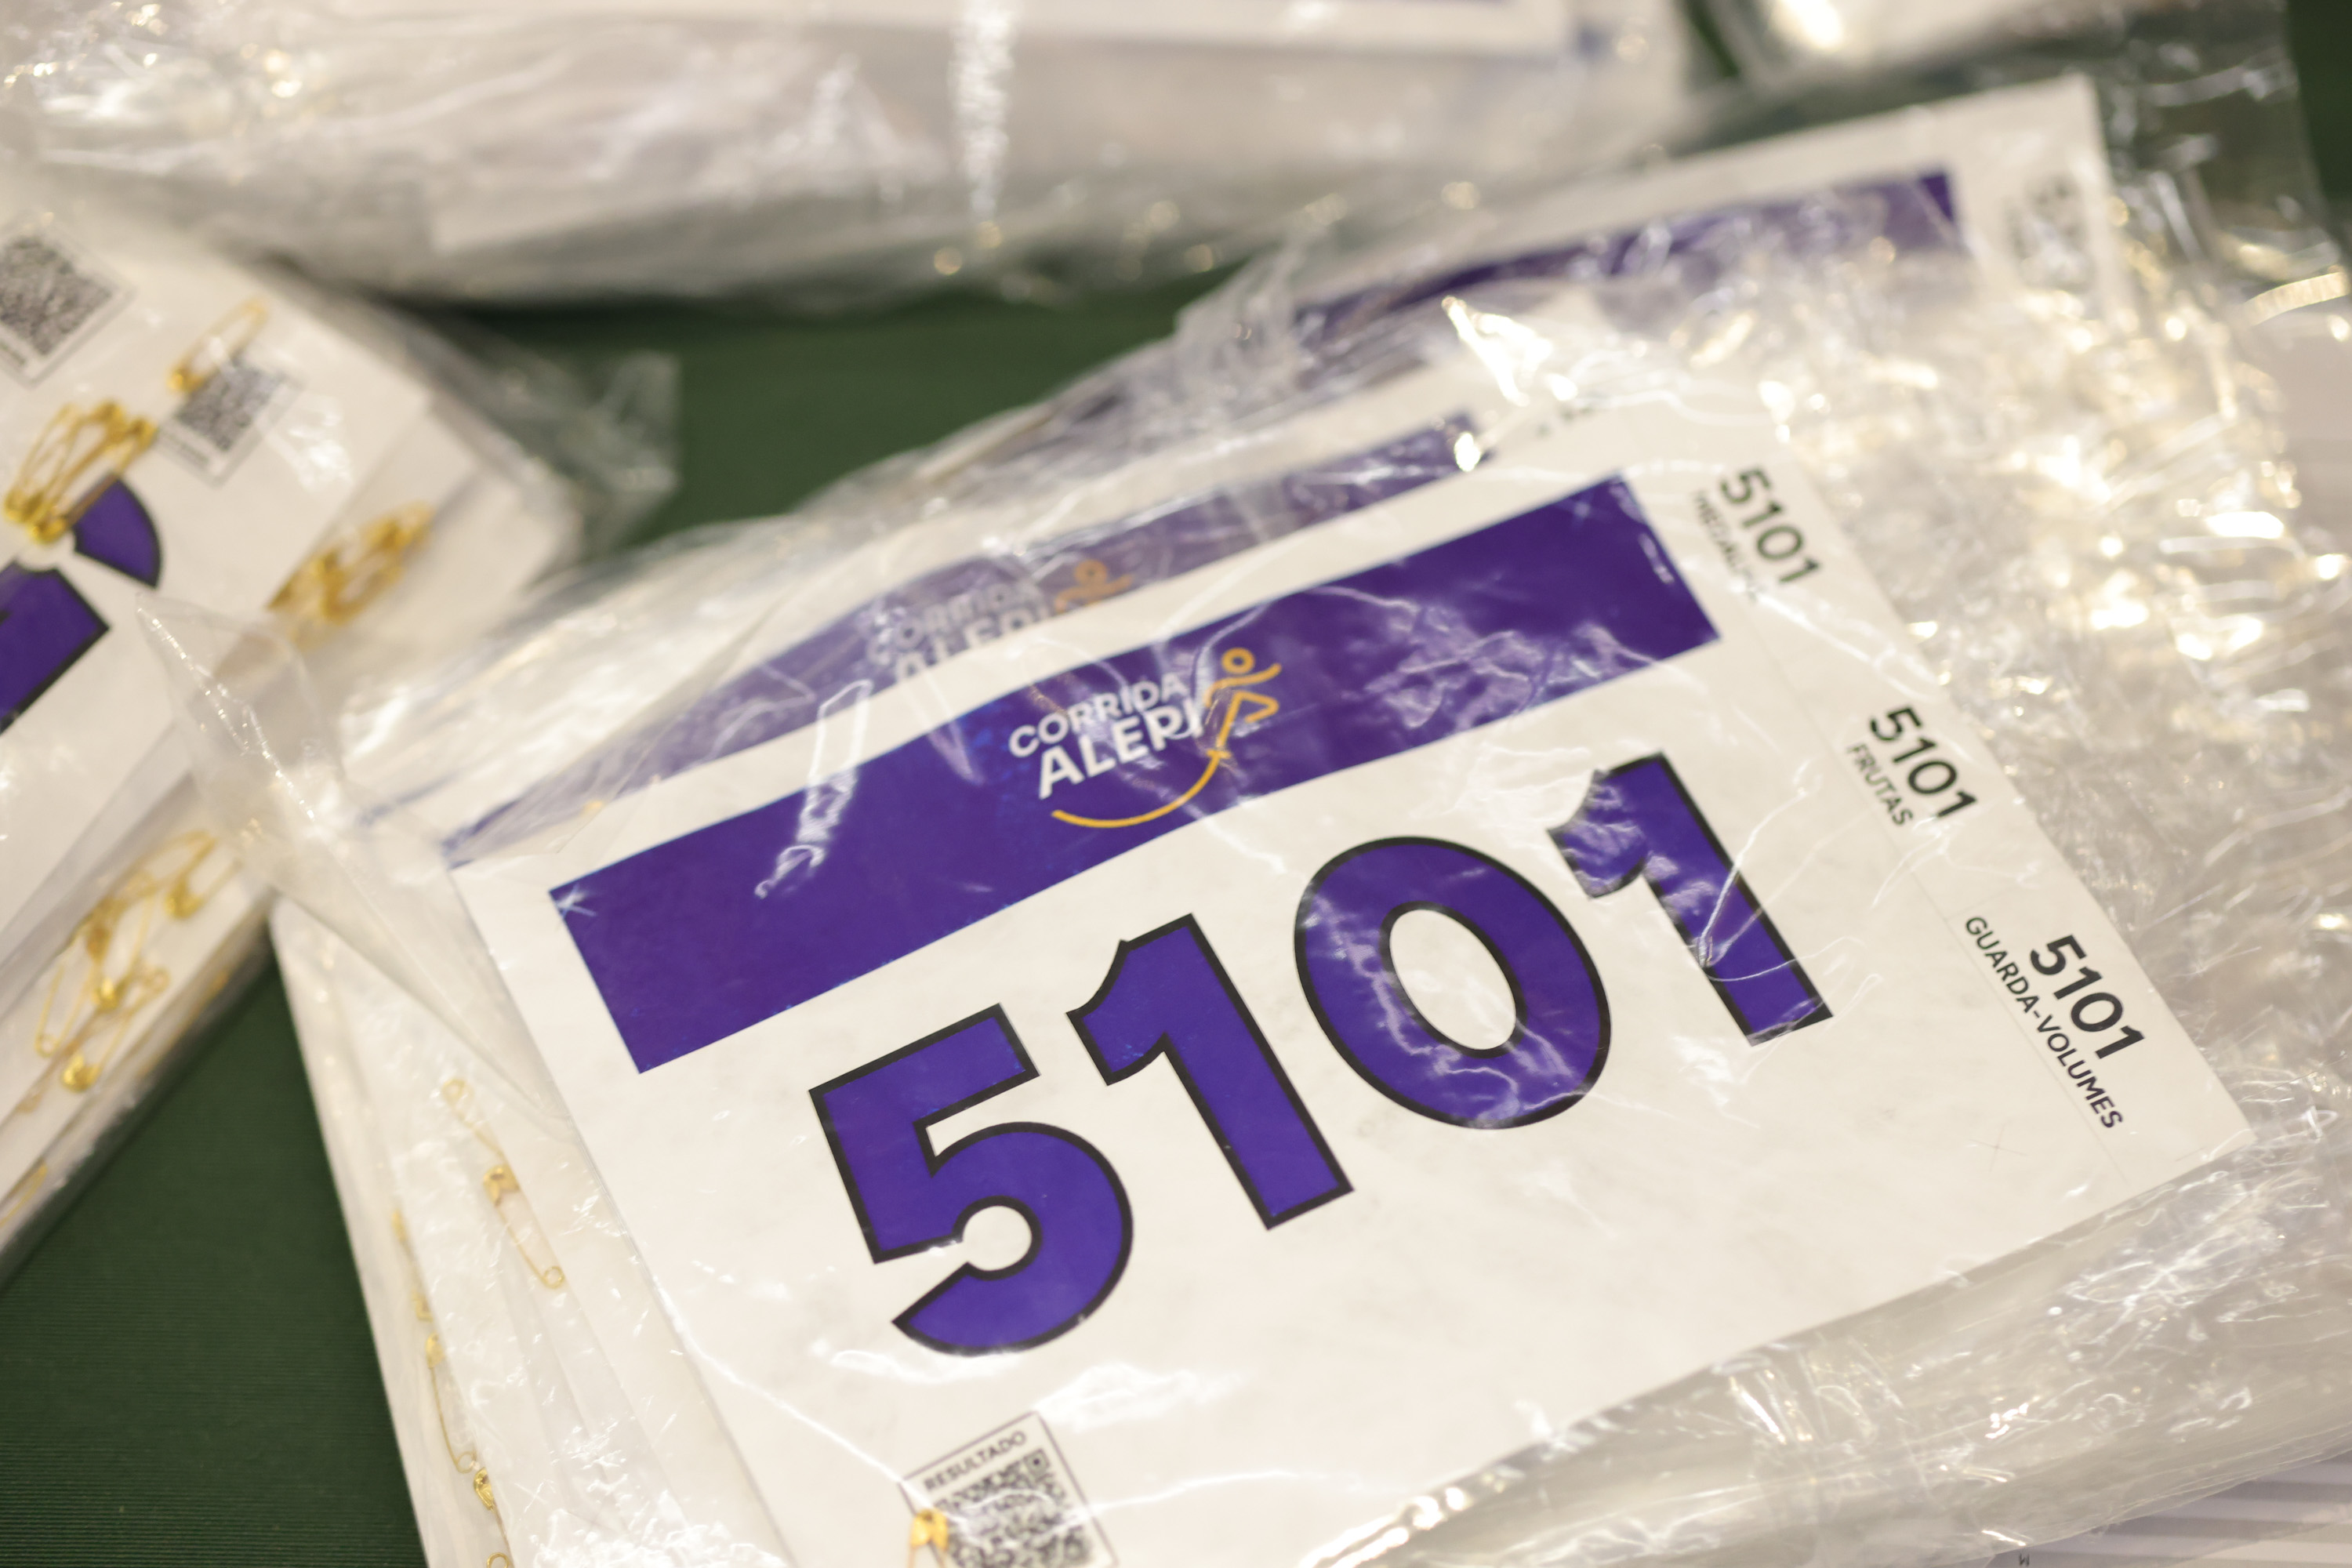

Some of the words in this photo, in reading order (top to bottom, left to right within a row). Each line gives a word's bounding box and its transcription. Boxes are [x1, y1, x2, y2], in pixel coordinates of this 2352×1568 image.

[1719, 468, 1820, 585] 5101
[1008, 672, 1190, 758] CORRIDA
[1868, 706, 1976, 819] 5101
[1846, 743, 1914, 826] FRUTAS
[808, 751, 1833, 1357] 5101
[1965, 916, 2124, 1128] GUARDA-VOLUMES
[2030, 934, 2145, 1060] 5101
[924, 1430, 1027, 1491] RESULTADO
